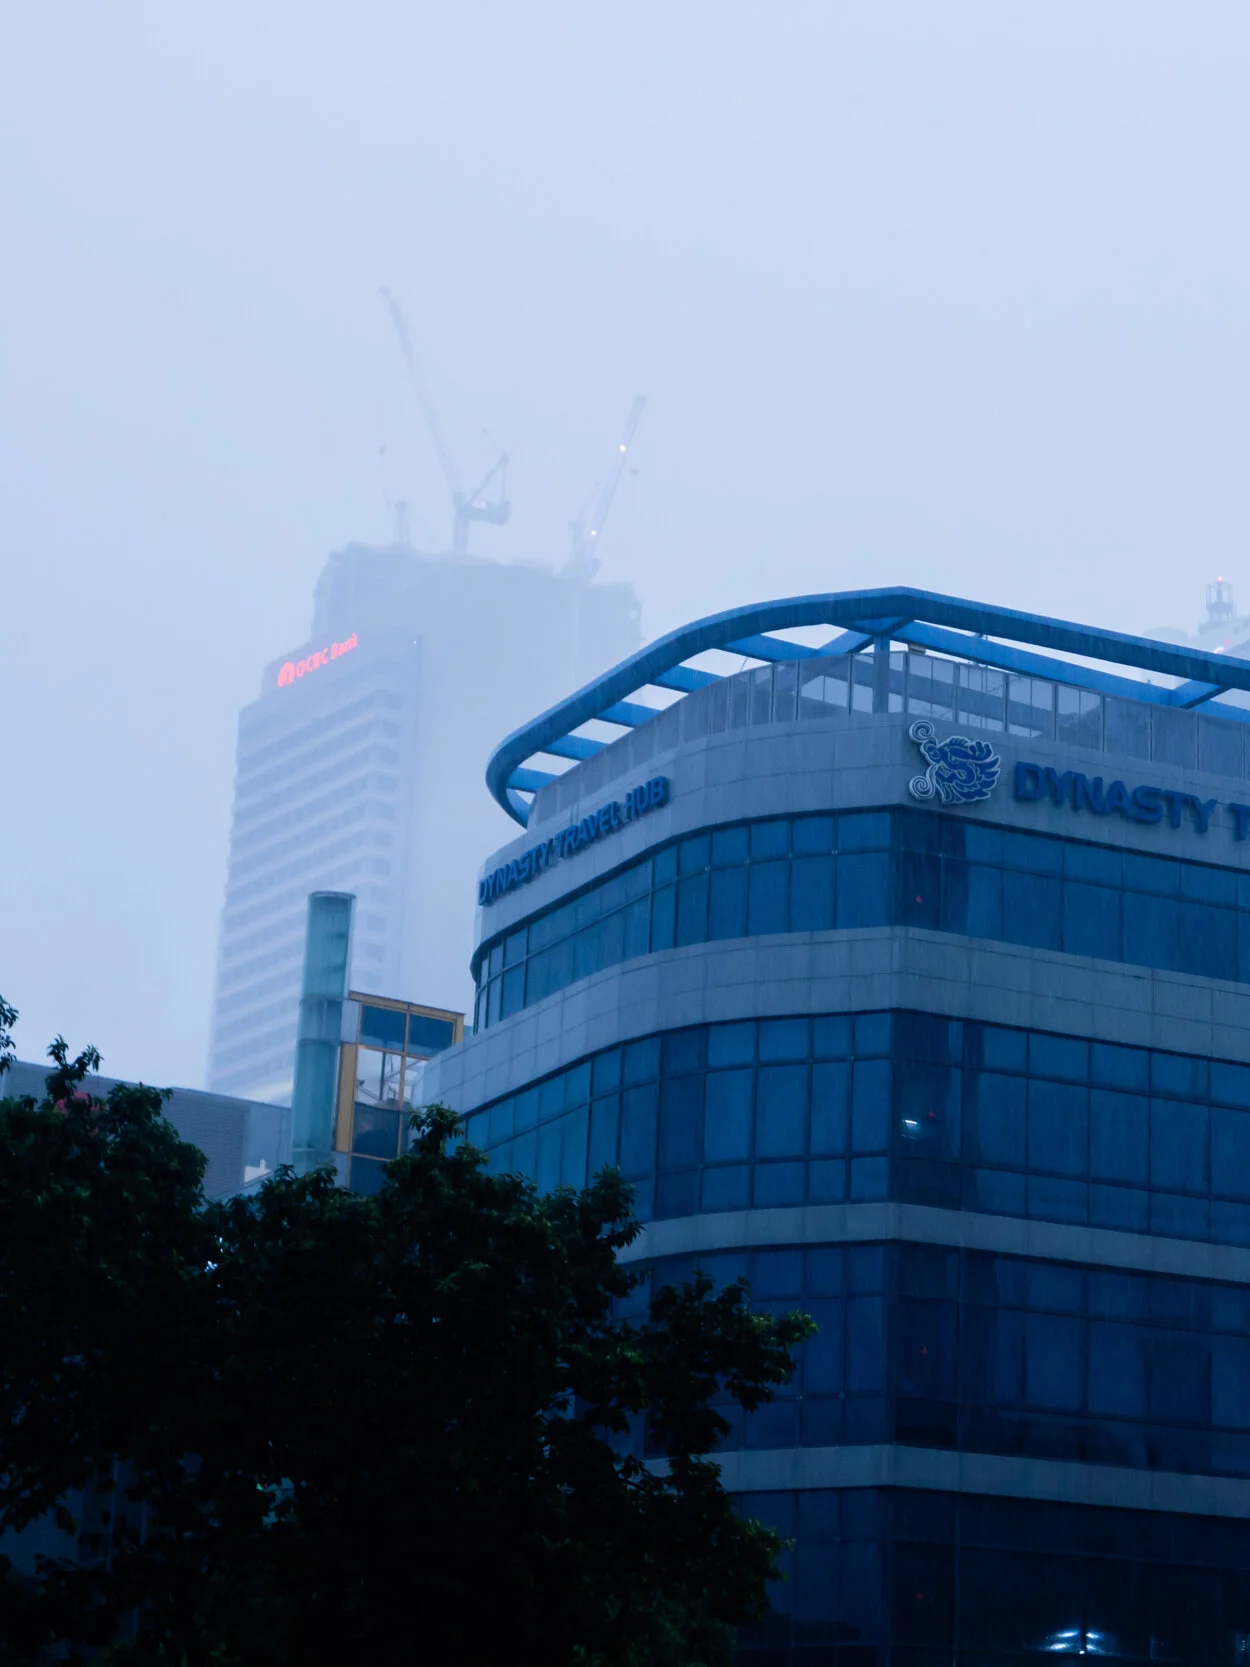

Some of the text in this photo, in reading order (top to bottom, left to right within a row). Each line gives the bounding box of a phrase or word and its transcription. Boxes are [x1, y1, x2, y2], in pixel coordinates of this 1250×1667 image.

[478, 775, 671, 905] DYNASTY TRAVEL HUB
[1014, 761, 1216, 833] DYNASTY
